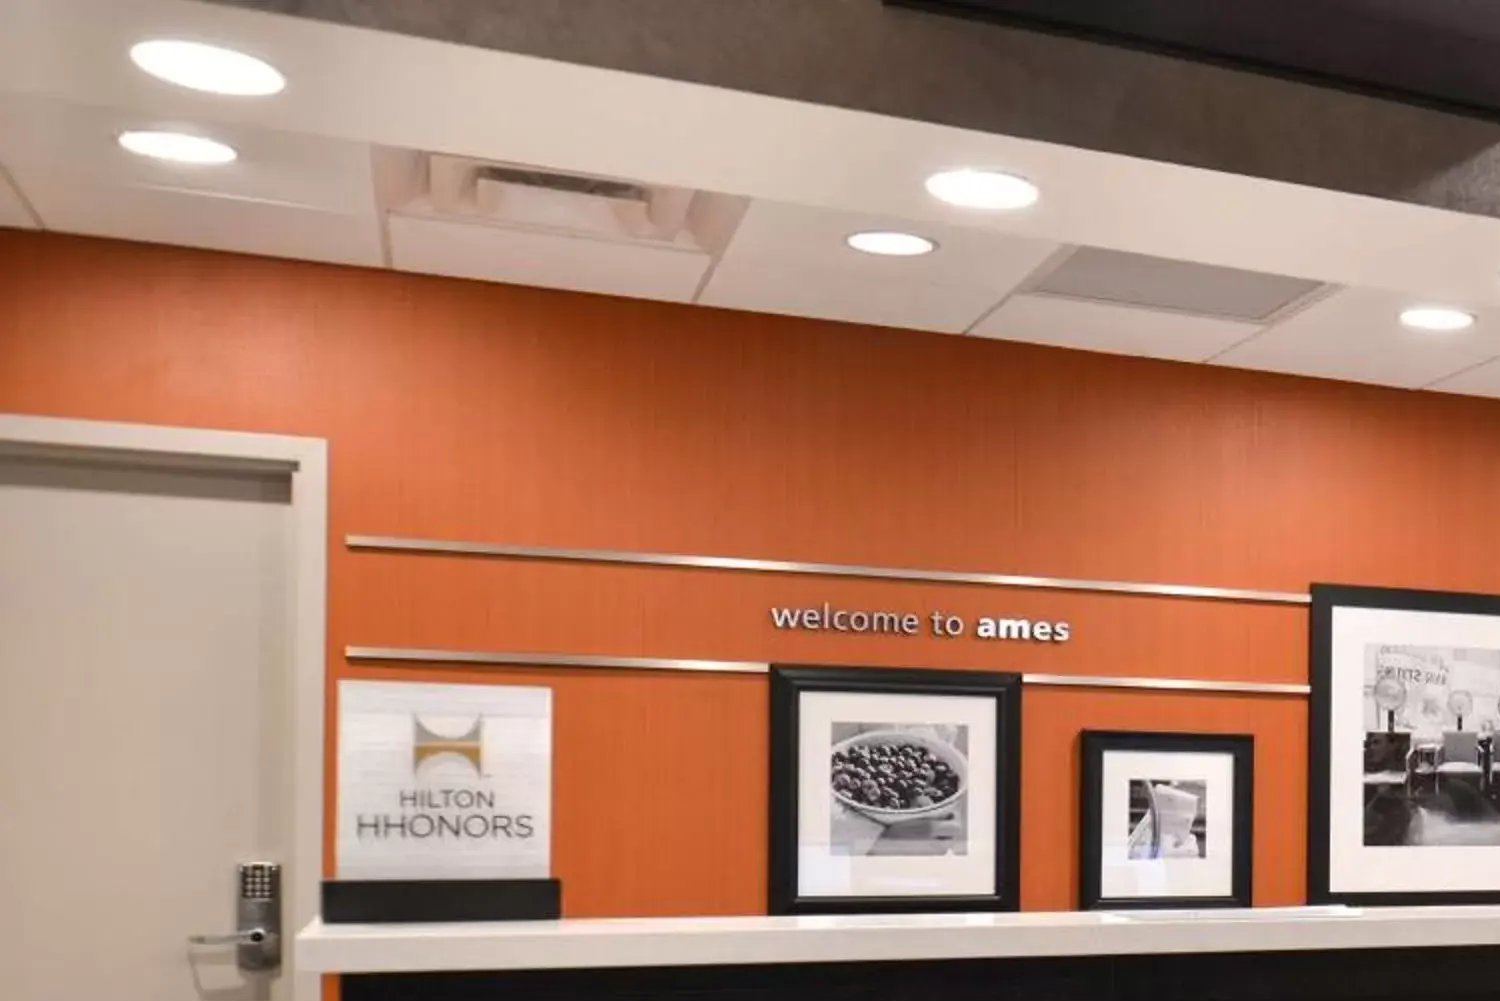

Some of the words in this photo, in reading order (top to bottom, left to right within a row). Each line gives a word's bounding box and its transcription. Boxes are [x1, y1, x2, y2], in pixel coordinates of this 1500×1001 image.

[771, 601, 920, 634] welcome
[930, 610, 964, 636] to
[977, 617, 1070, 642] ames
[400, 789, 494, 808] HILTON
[356, 813, 534, 839] HHONORS
